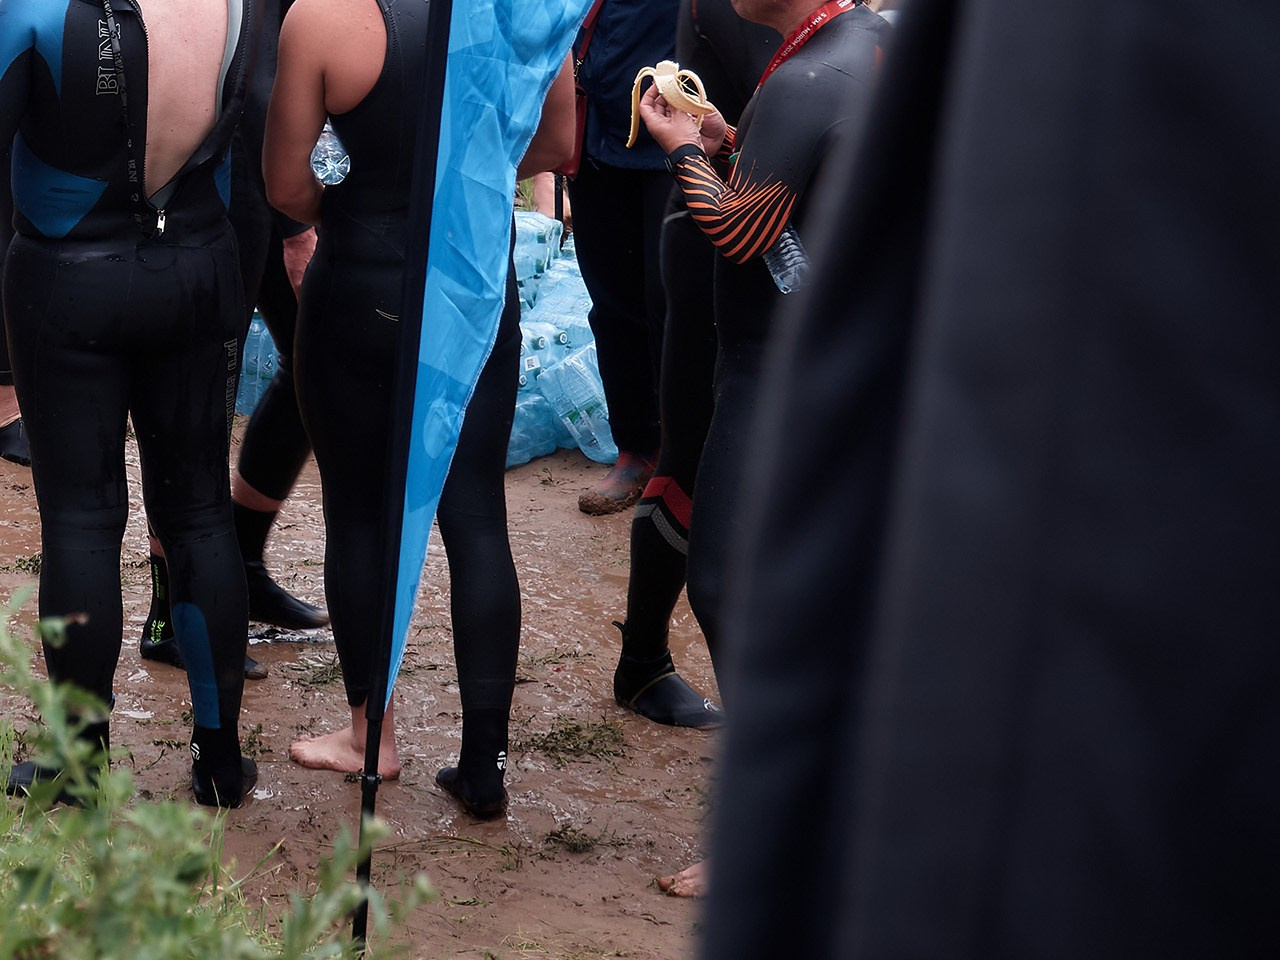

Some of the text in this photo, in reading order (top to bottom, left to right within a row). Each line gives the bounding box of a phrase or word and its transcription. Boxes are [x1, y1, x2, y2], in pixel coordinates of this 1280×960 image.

[810, 14, 823, 27] KM
[790, 25, 811, 47] MUROM
[779, 43, 795, 59] 2025
